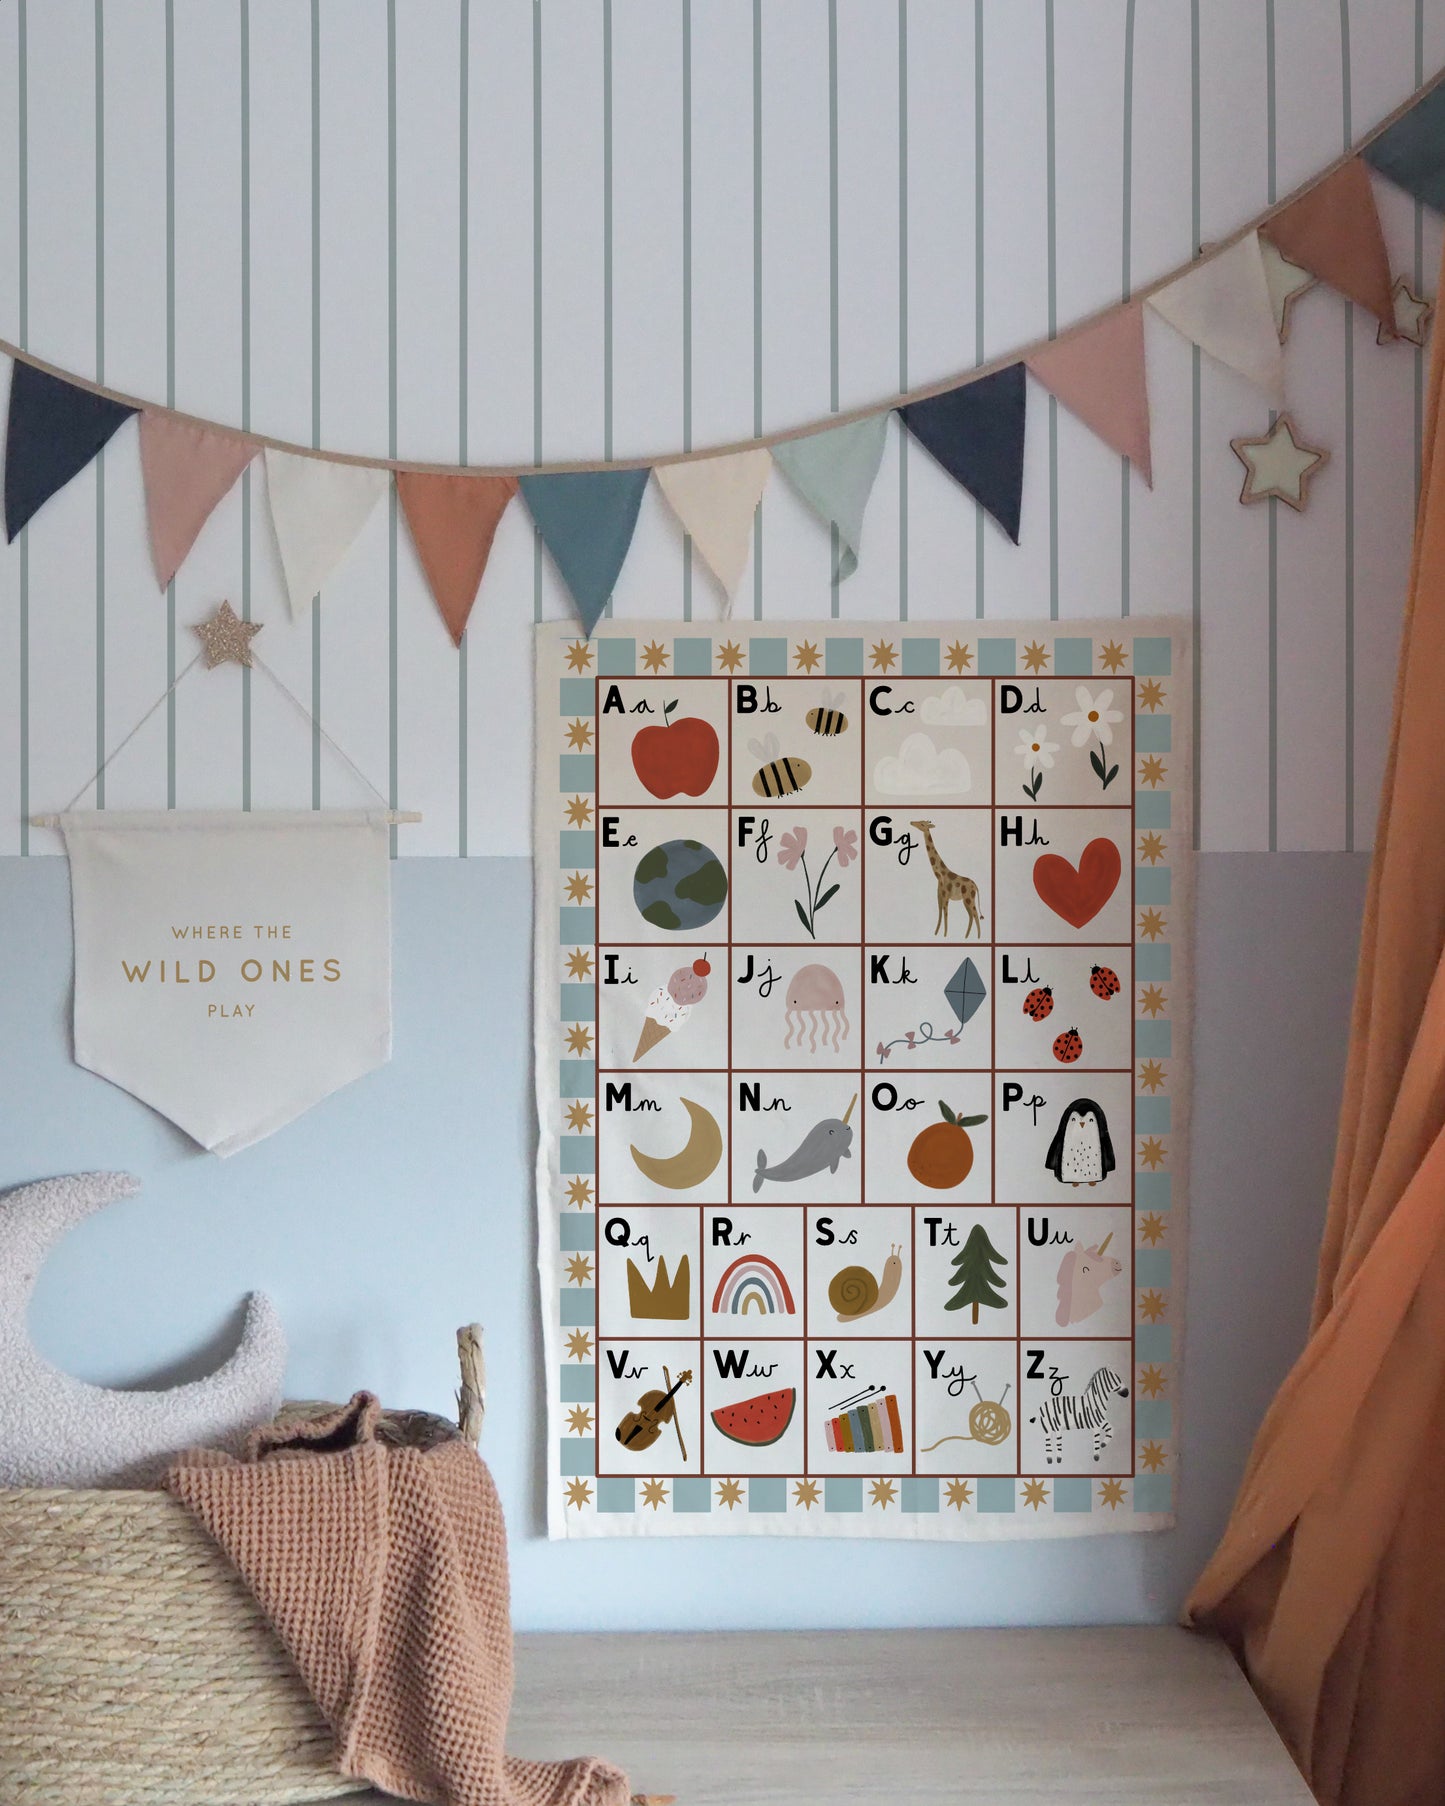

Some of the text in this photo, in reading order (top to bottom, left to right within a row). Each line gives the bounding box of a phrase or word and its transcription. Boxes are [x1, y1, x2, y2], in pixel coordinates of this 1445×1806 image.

[171, 925, 293, 940] WHERE THE
[121, 958, 342, 984] WILD ONES
[207, 1003, 256, 1018] PLAY
